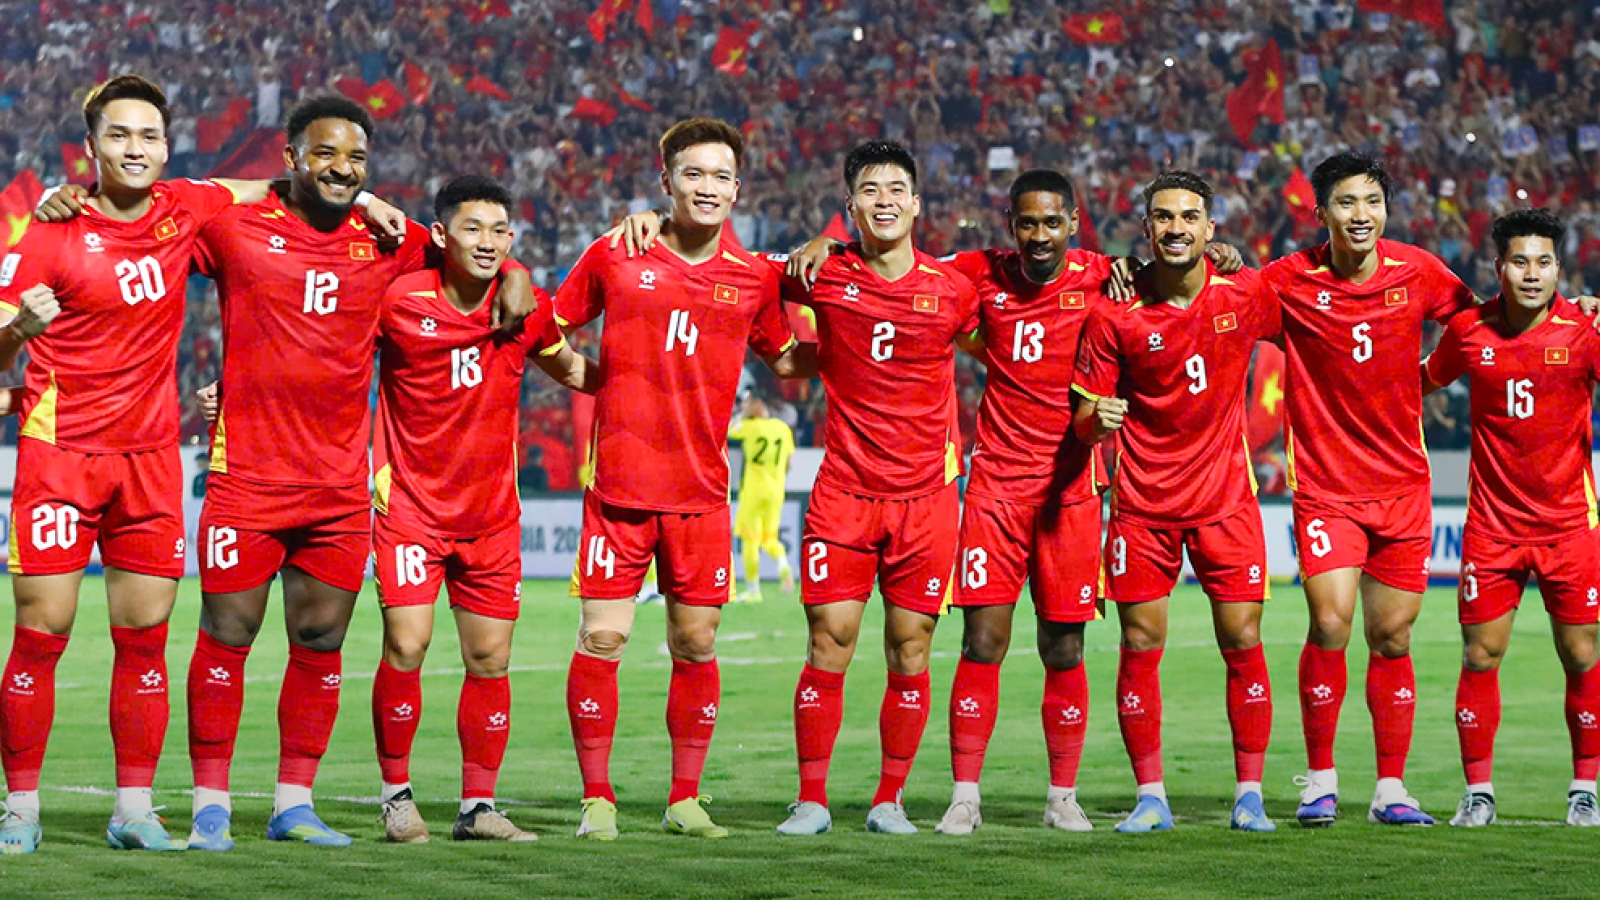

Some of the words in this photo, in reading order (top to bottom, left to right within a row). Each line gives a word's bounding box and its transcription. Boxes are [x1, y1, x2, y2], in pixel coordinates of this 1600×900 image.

[114, 254, 166, 307] 20
[302, 269, 340, 316] 12
[664, 308, 699, 357] 14
[871, 321, 895, 362] 2
[1012, 319, 1046, 363] 13
[1351, 321, 1373, 364] 5
[450, 345, 483, 391] 18
[1185, 353, 1208, 396] 9
[1506, 378, 1535, 420] 15
[752, 436, 782, 467] 21
[31, 503, 80, 551] 20
[206, 525, 239, 570] 12
[1306, 518, 1333, 558] 5
[395, 543, 428, 587] 18
[586, 534, 616, 580] 14
[808, 541, 829, 583] 2
[961, 546, 988, 590] 13
[1111, 535, 1127, 577] 9
